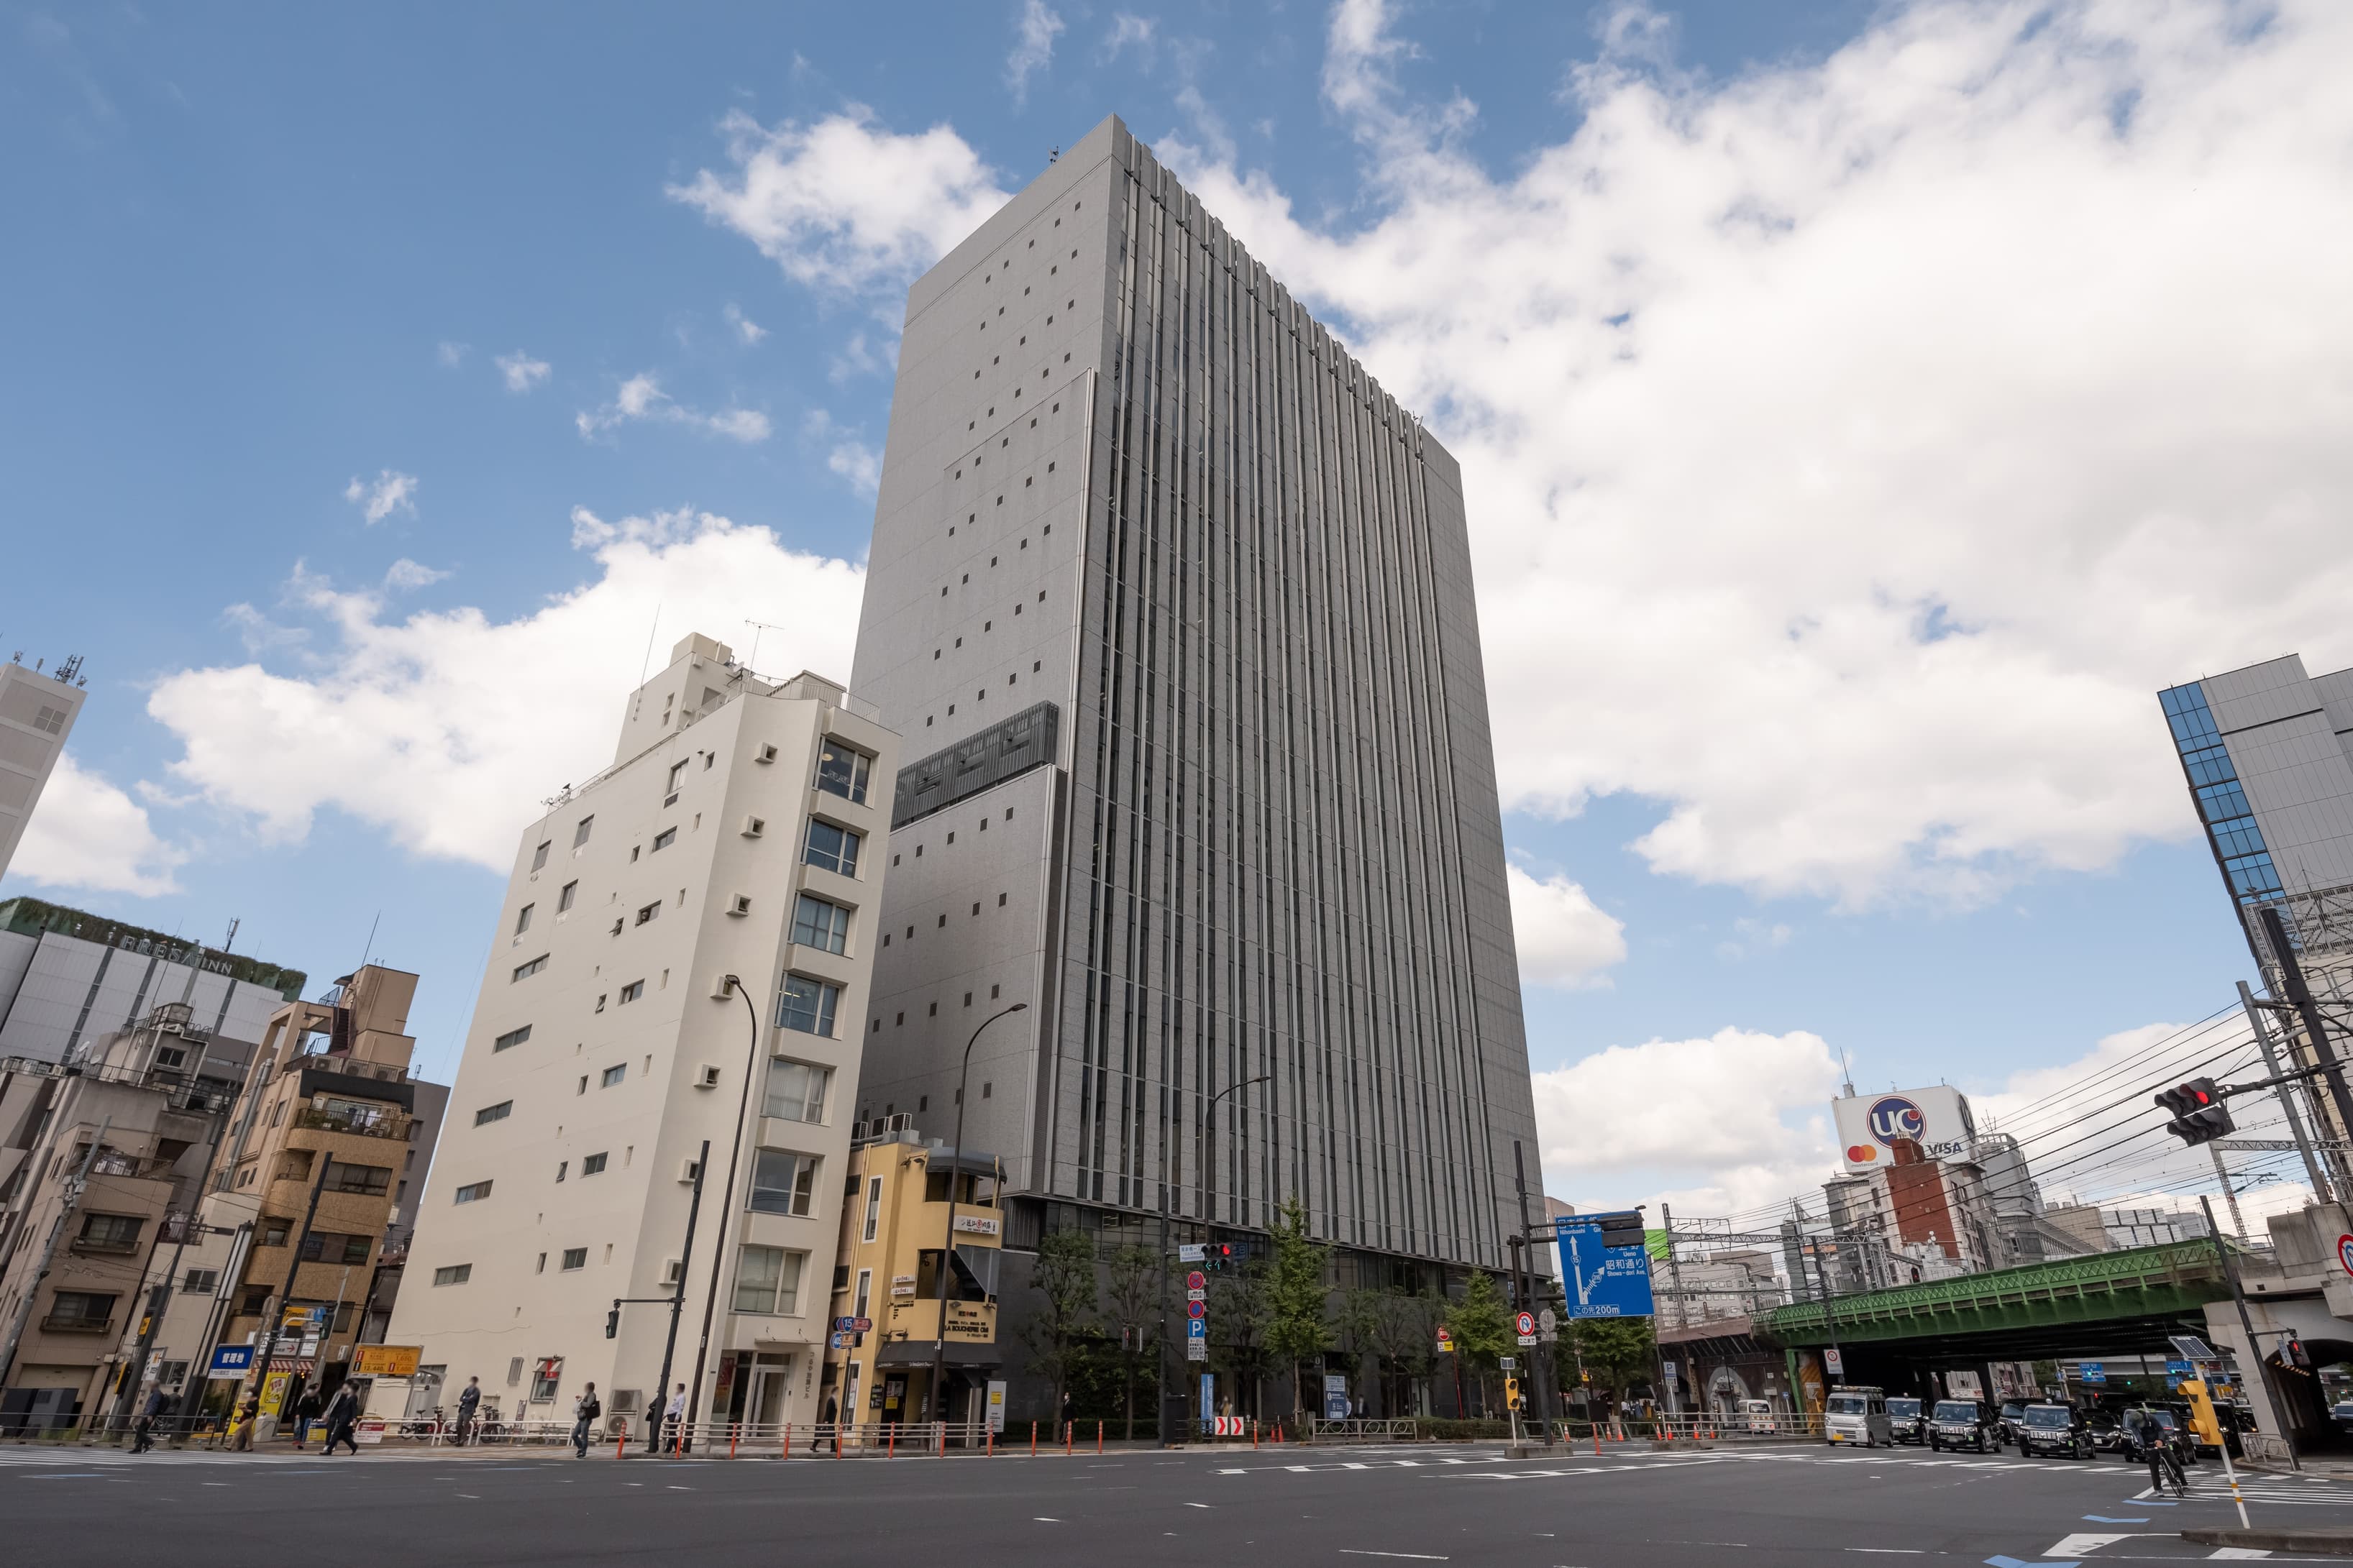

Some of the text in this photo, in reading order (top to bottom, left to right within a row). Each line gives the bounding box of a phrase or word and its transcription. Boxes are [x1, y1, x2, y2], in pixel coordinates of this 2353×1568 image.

[121, 935, 232, 974] FRESA INN
[1872, 1108, 1921, 1137] UC
[1926, 1142, 1963, 1155] VISA
[1558, 1216, 1585, 1229] 日本橋
[1606, 1258, 1644, 1270] 昭和通り
[1575, 1306, 1619, 1315] この先200m
[844, 1318, 853, 1328] 15
[1192, 1321, 1202, 1337] P
[221, 1352, 245, 1364] 管理地
